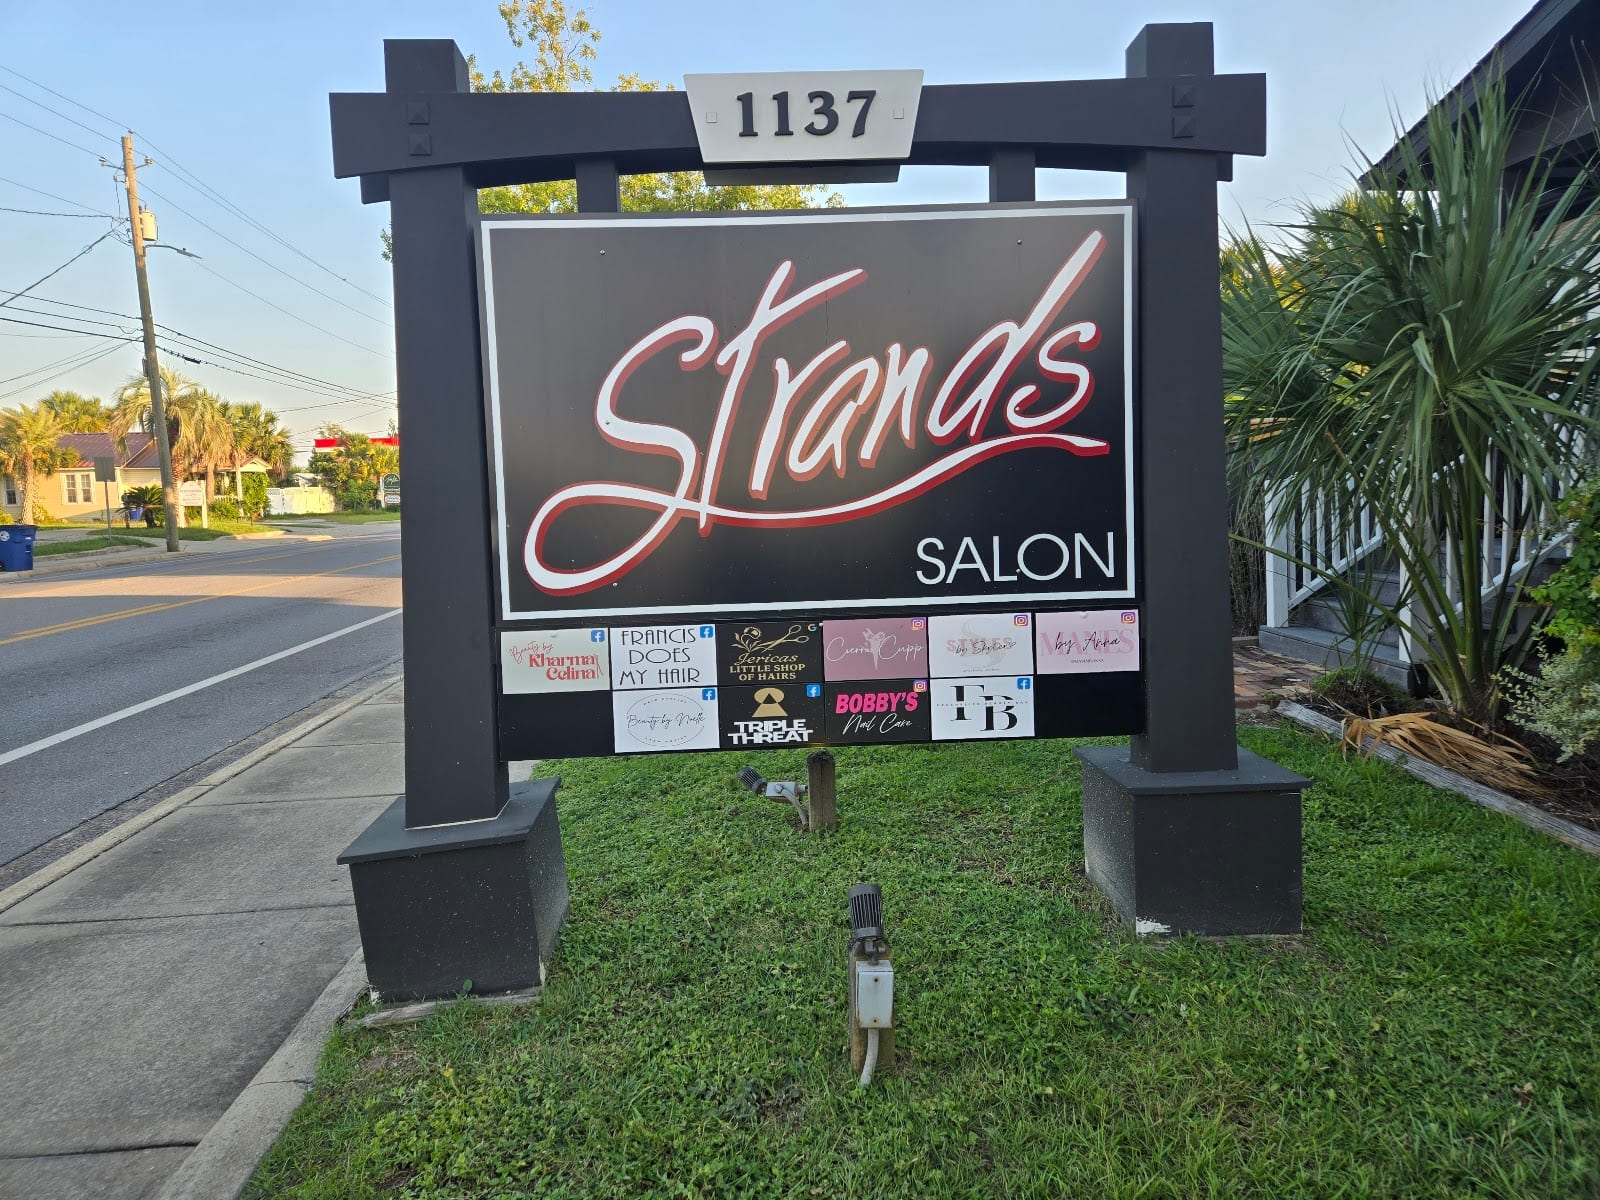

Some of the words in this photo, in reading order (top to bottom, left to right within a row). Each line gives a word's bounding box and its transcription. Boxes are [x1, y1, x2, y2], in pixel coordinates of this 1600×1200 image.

[737, 89, 877, 138] 1137
[523, 230, 1110, 596] Strands
[915, 531, 1115, 585] SALON
[621, 628, 696, 646] FRANCIS
[1054, 631, 1074, 655] by
[1083, 631, 1121, 651] Anna
[509, 640, 540, 664] Beauty
[542, 642, 554, 655] by
[629, 647, 691, 665] DOES
[878, 635, 925, 663] Cupp
[955, 644, 968, 657] by
[528, 653, 596, 667] Kharma
[729, 664, 771, 674] LITTLE
[773, 663, 806, 673] SHOP
[733, 653, 799, 666] Jericas
[545, 666, 596, 681] Celina
[619, 668, 648, 685] MY
[657, 667, 701, 684] HAIR
[738, 673, 755, 682] OF
[758, 672, 797, 681] HAIRS
[835, 691, 919, 714] BOBBY'S
[733, 718, 807, 733] TRIPLE
[842, 713, 877, 735] Nail
[879, 712, 913, 734] Care
[727, 729, 814, 745] THREAT
